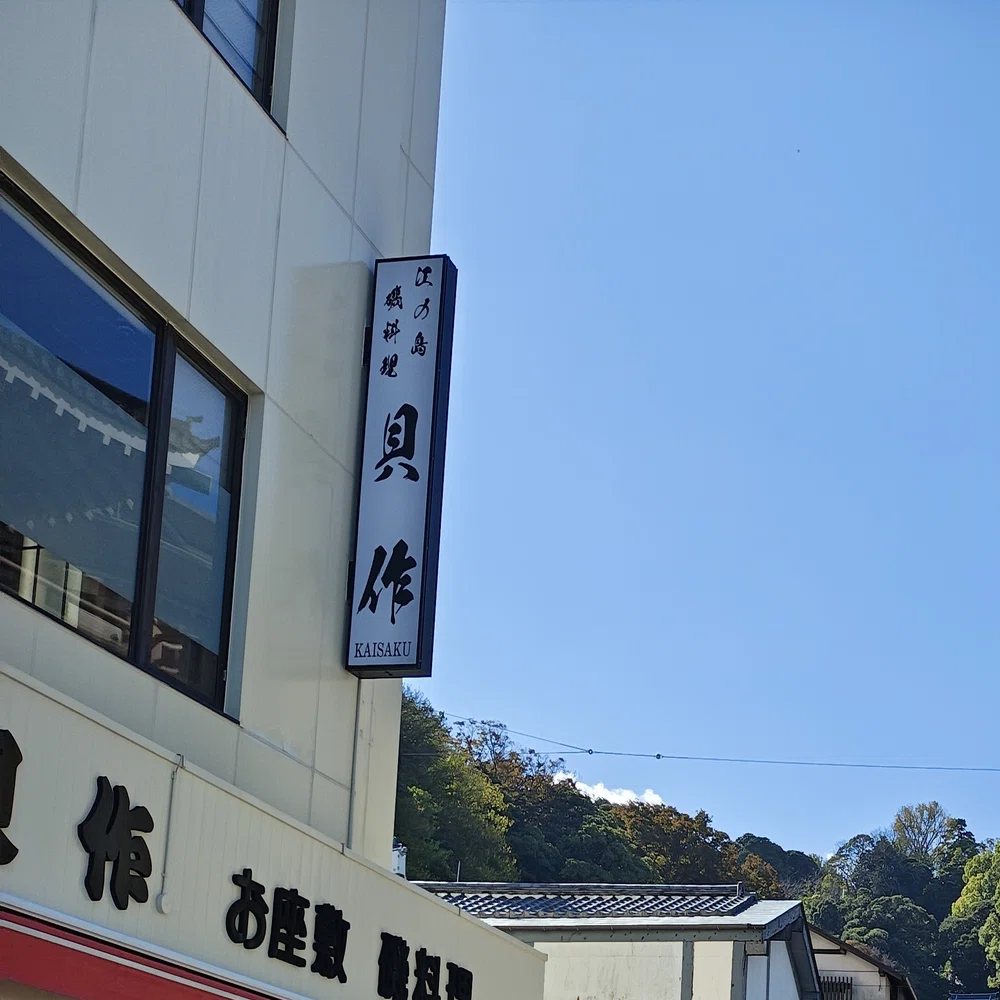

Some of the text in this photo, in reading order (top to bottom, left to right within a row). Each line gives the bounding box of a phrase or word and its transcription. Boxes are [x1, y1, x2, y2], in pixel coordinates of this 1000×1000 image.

[379, 285, 404, 378] 磯料理
[410, 266, 433, 357] 江の島
[357, 403, 419, 625] 貝作
[354, 641, 412, 659] KAISAKU
[225, 868, 351, 983] お座敷
